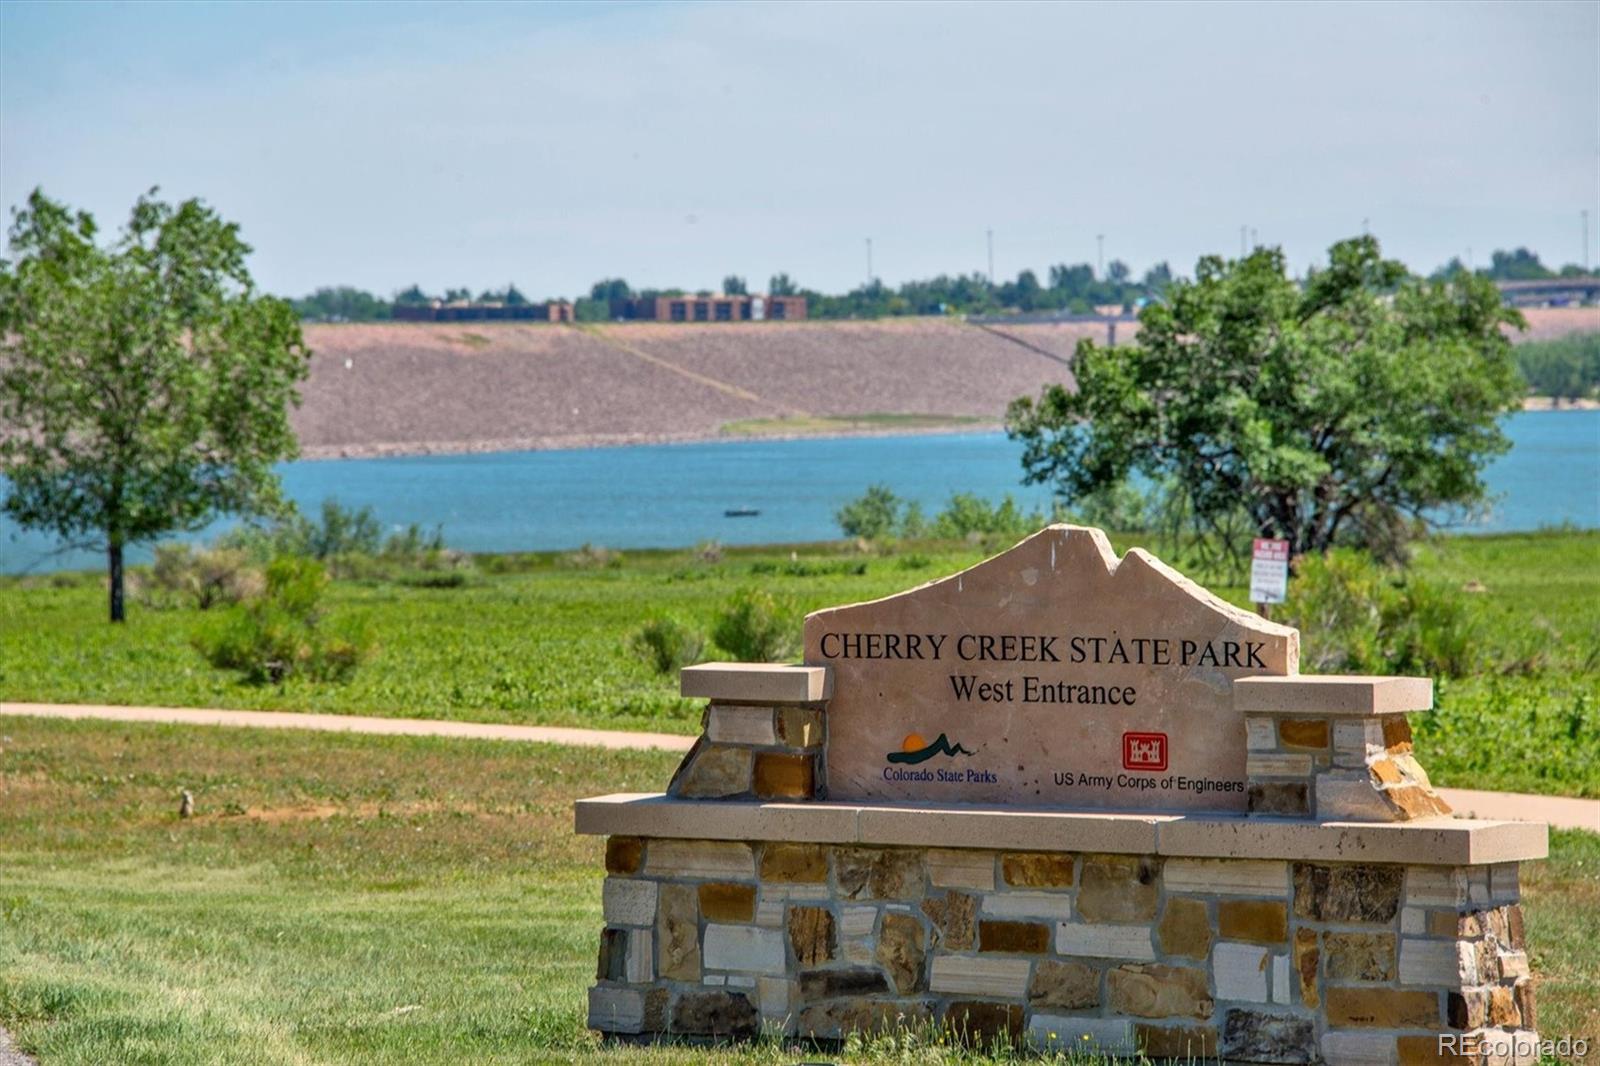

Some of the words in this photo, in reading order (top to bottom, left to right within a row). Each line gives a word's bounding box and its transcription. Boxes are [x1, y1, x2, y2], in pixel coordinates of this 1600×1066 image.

[820, 632, 948, 660] CHERRY
[957, 634, 1061, 662] CREEK
[1070, 637, 1170, 665] STATE
[1180, 640, 1267, 669] PARK
[950, 675, 1013, 702] West
[1023, 676, 1136, 705] Entrance
[883, 767, 933, 783] Colorado
[936, 768, 964, 783] State
[966, 769, 997, 784] Parks
[1054, 773, 1075, 786] US
[1078, 773, 1114, 790] Army
[1117, 774, 1157, 791] Corps
[1160, 776, 1174, 790] of
[1177, 776, 1244, 794] Engineers
